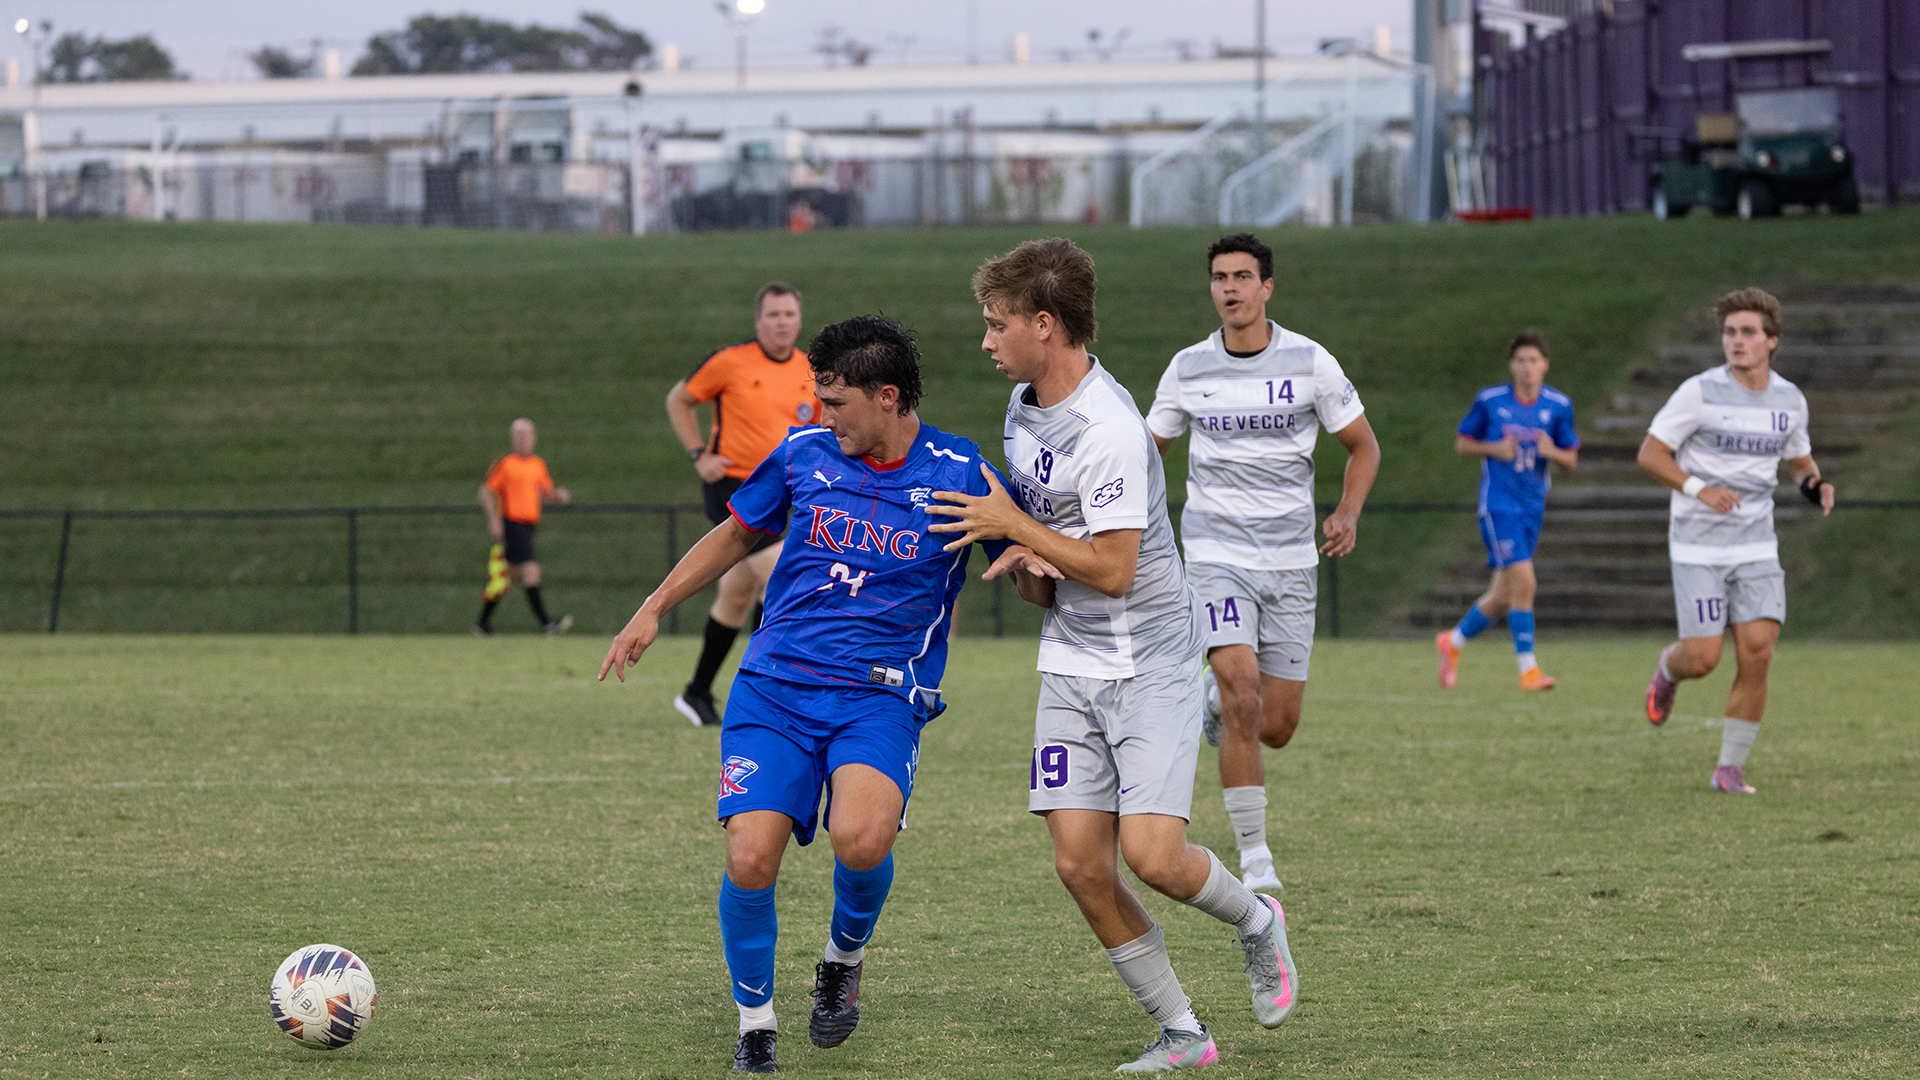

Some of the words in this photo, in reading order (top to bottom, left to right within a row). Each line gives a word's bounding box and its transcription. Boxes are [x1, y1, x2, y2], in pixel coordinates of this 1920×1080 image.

[1265, 379, 1295, 404] 14
[1198, 413, 1295, 431] TREVECCA
[1770, 411, 1789, 431] 10
[1034, 447, 1054, 485] 19
[805, 504, 919, 559] KING
[1204, 597, 1241, 633] 14
[1695, 598, 1721, 623] 10
